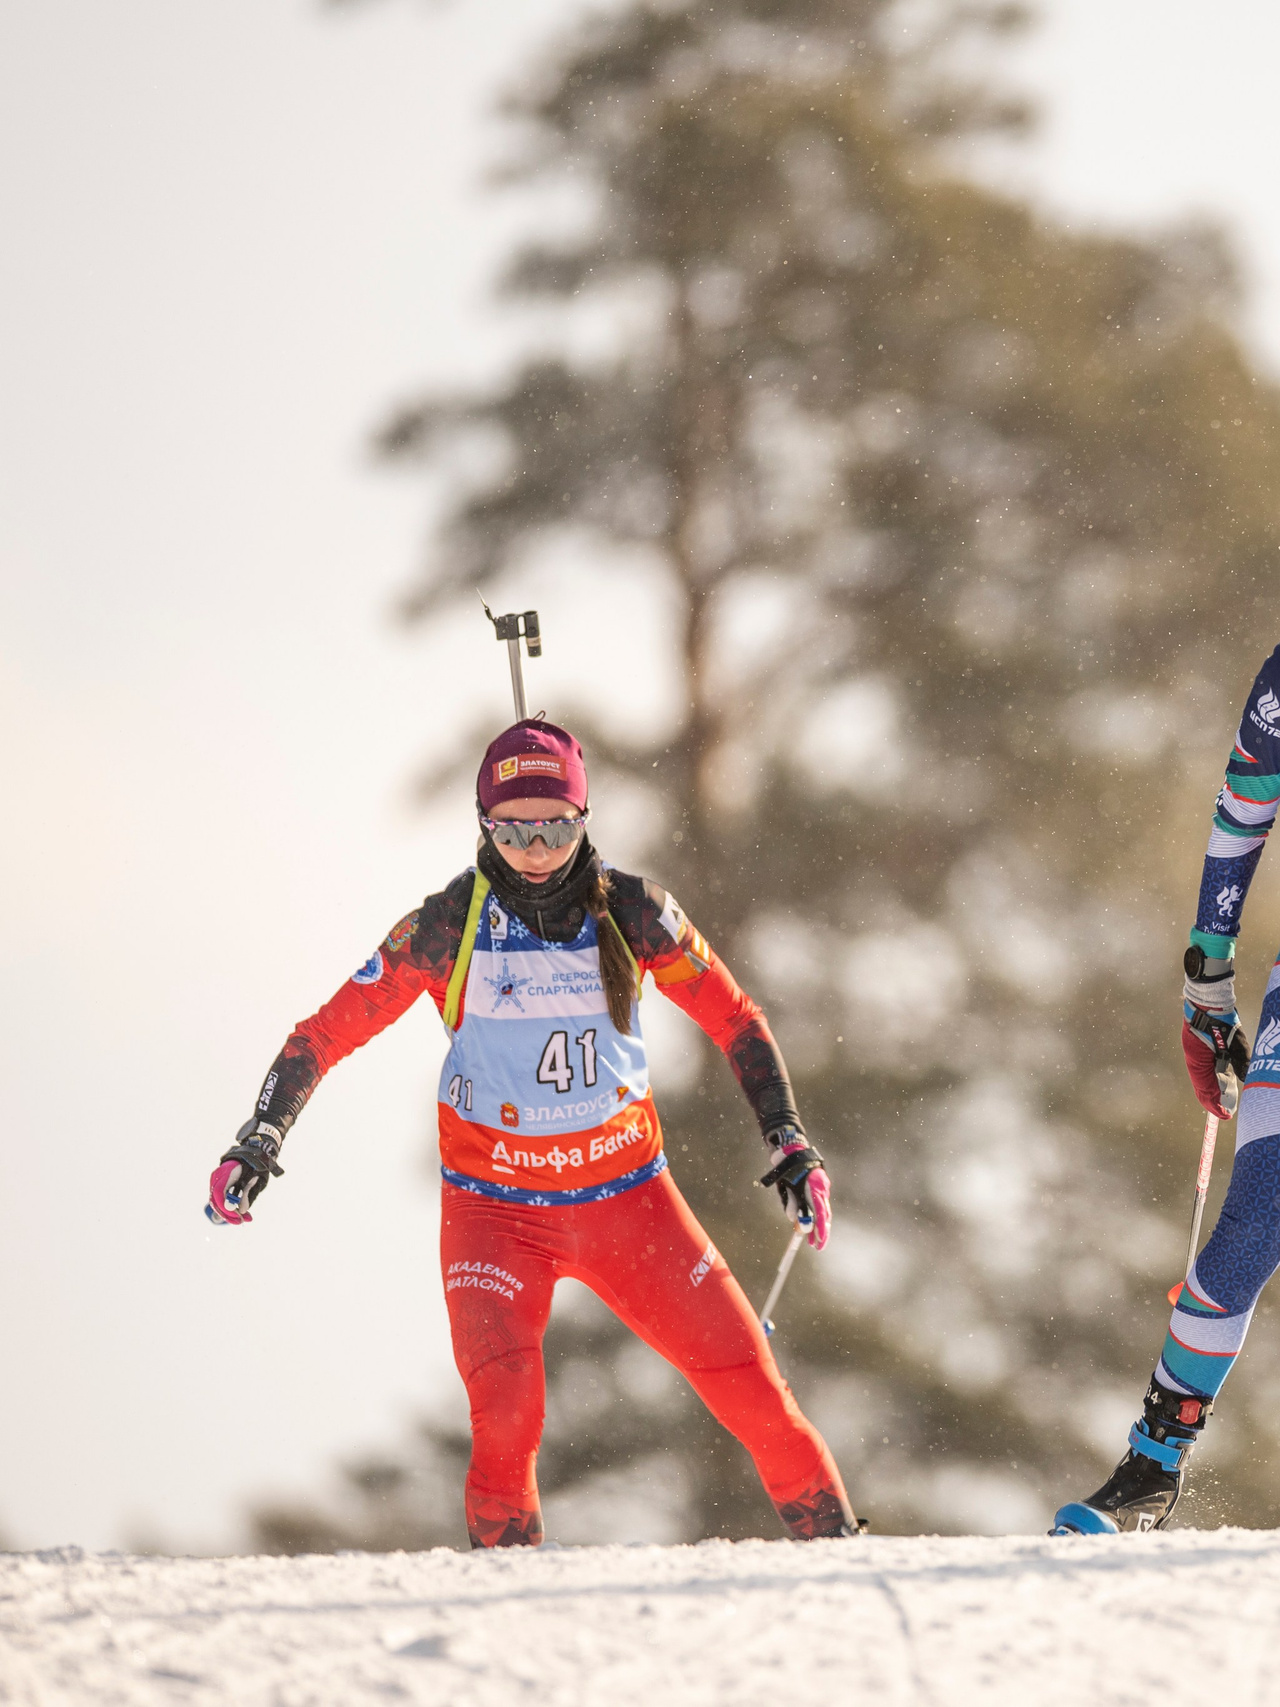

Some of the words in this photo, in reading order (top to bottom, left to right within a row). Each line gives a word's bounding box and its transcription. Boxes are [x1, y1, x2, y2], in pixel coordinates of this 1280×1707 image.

[520, 759, 561, 769] ЗЛАТОУСТ
[1211, 921, 1231, 932] Visit
[527, 983, 605, 997] СПАРТАКИА
[537, 1028, 597, 1093] 41
[448, 1074, 473, 1111] 41
[523, 1089, 614, 1122] ЗЛАТОУСТ
[491, 1140, 584, 1174] Альфа
[588, 1122, 645, 1162] Банк
[447, 1260, 524, 1292] АКАДЕМИЯ
